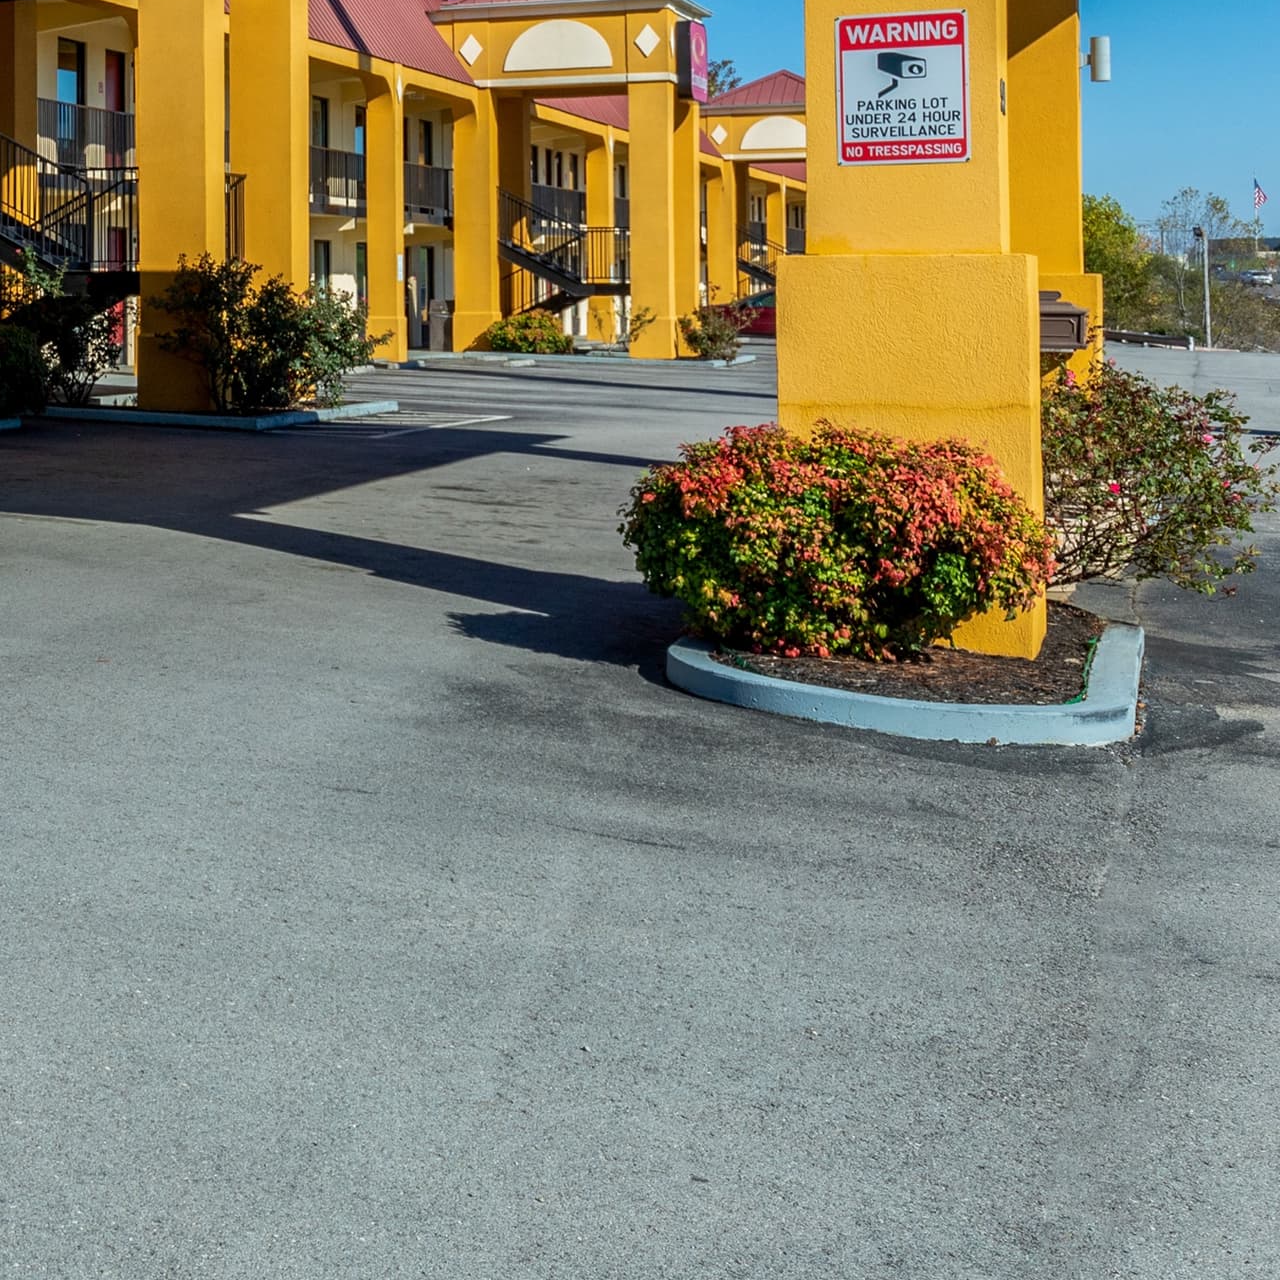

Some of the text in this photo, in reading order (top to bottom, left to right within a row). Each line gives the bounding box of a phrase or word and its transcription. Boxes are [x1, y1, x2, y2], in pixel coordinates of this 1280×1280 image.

[845, 19, 958, 45] WARNING
[857, 97, 948, 111] PARKING LOT
[845, 110, 961, 125] UNDER 24 HOUR
[851, 124, 956, 138] SURVEILLANCE
[845, 143, 962, 158] NO TRESSPASSING
